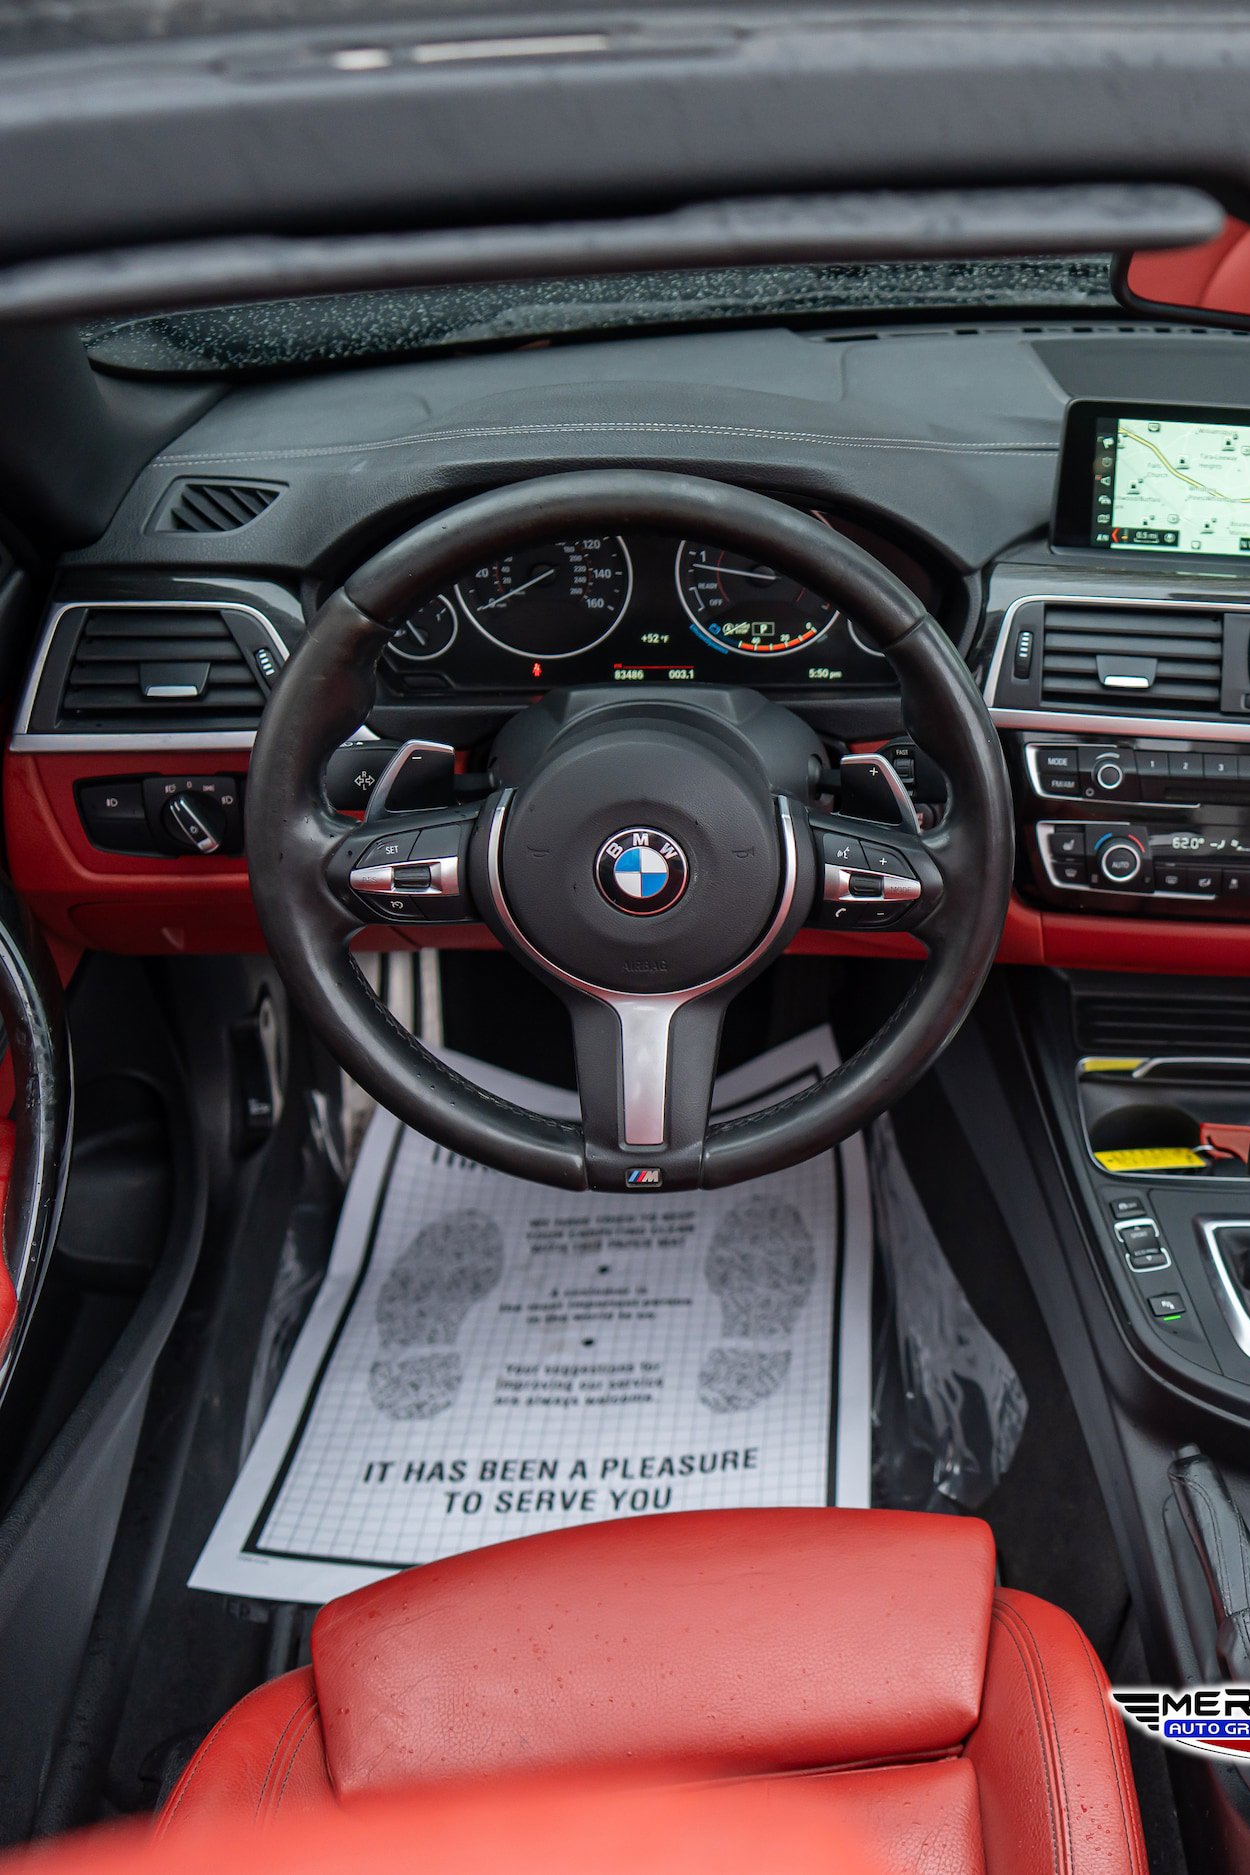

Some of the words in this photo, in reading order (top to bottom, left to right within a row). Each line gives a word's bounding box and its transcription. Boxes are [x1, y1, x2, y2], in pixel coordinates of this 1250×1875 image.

[582, 540, 601, 550] 120
[700, 550, 706, 562] 1
[592, 568, 612, 579] 140
[586, 598, 604, 609] 160
[709, 598, 724, 606] OFF
[759, 624, 768, 634] P
[641, 633, 660, 644] +52
[614, 669, 644, 680] 83486
[668, 669, 694, 680] 003.1
[808, 668, 829, 679] 5:50
[829, 670, 843, 680] pm
[1048, 757, 1068, 766] MODE
[1150, 760, 1155, 768] 1
[1182, 762, 1188, 770] 2
[1218, 764, 1224, 772] 3
[361, 770, 367, 778] R
[385, 845, 399, 855] SET
[606, 832, 678, 860] BMW
[1112, 861, 1130, 869] AUTO
[362, 1462, 395, 1484] IT
[404, 1460, 468, 1484] HAS
[478, 1458, 560, 1482] BEEN
[569, 1459, 588, 1480] A
[599, 1446, 760, 1481] PLEASURE
[444, 1490, 483, 1515] TO
[494, 1488, 596, 1515] SERVE
[611, 1486, 674, 1513] YOU
